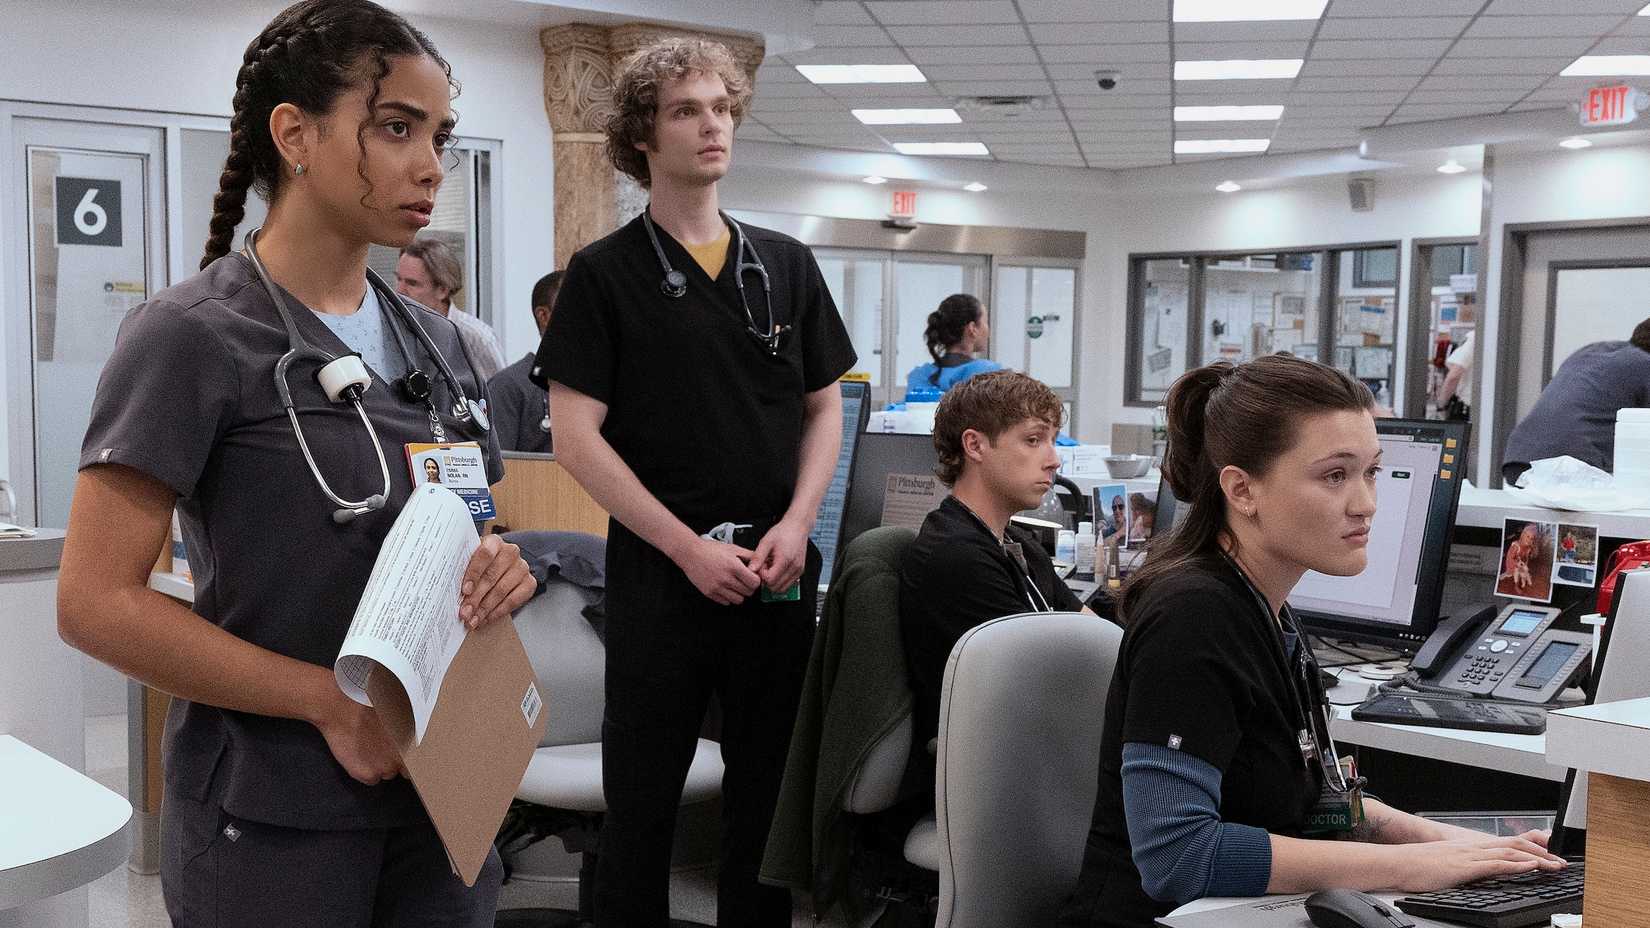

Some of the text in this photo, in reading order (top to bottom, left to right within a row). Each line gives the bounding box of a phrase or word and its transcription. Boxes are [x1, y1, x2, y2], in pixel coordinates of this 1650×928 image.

[1588, 86, 1628, 121] EXIT
[74, 188, 107, 236] 6
[893, 191, 916, 214] EXIT
[898, 476, 935, 489] Pittsburgh
[468, 499, 492, 515] SE
[1304, 813, 1346, 825] DOCTOR
